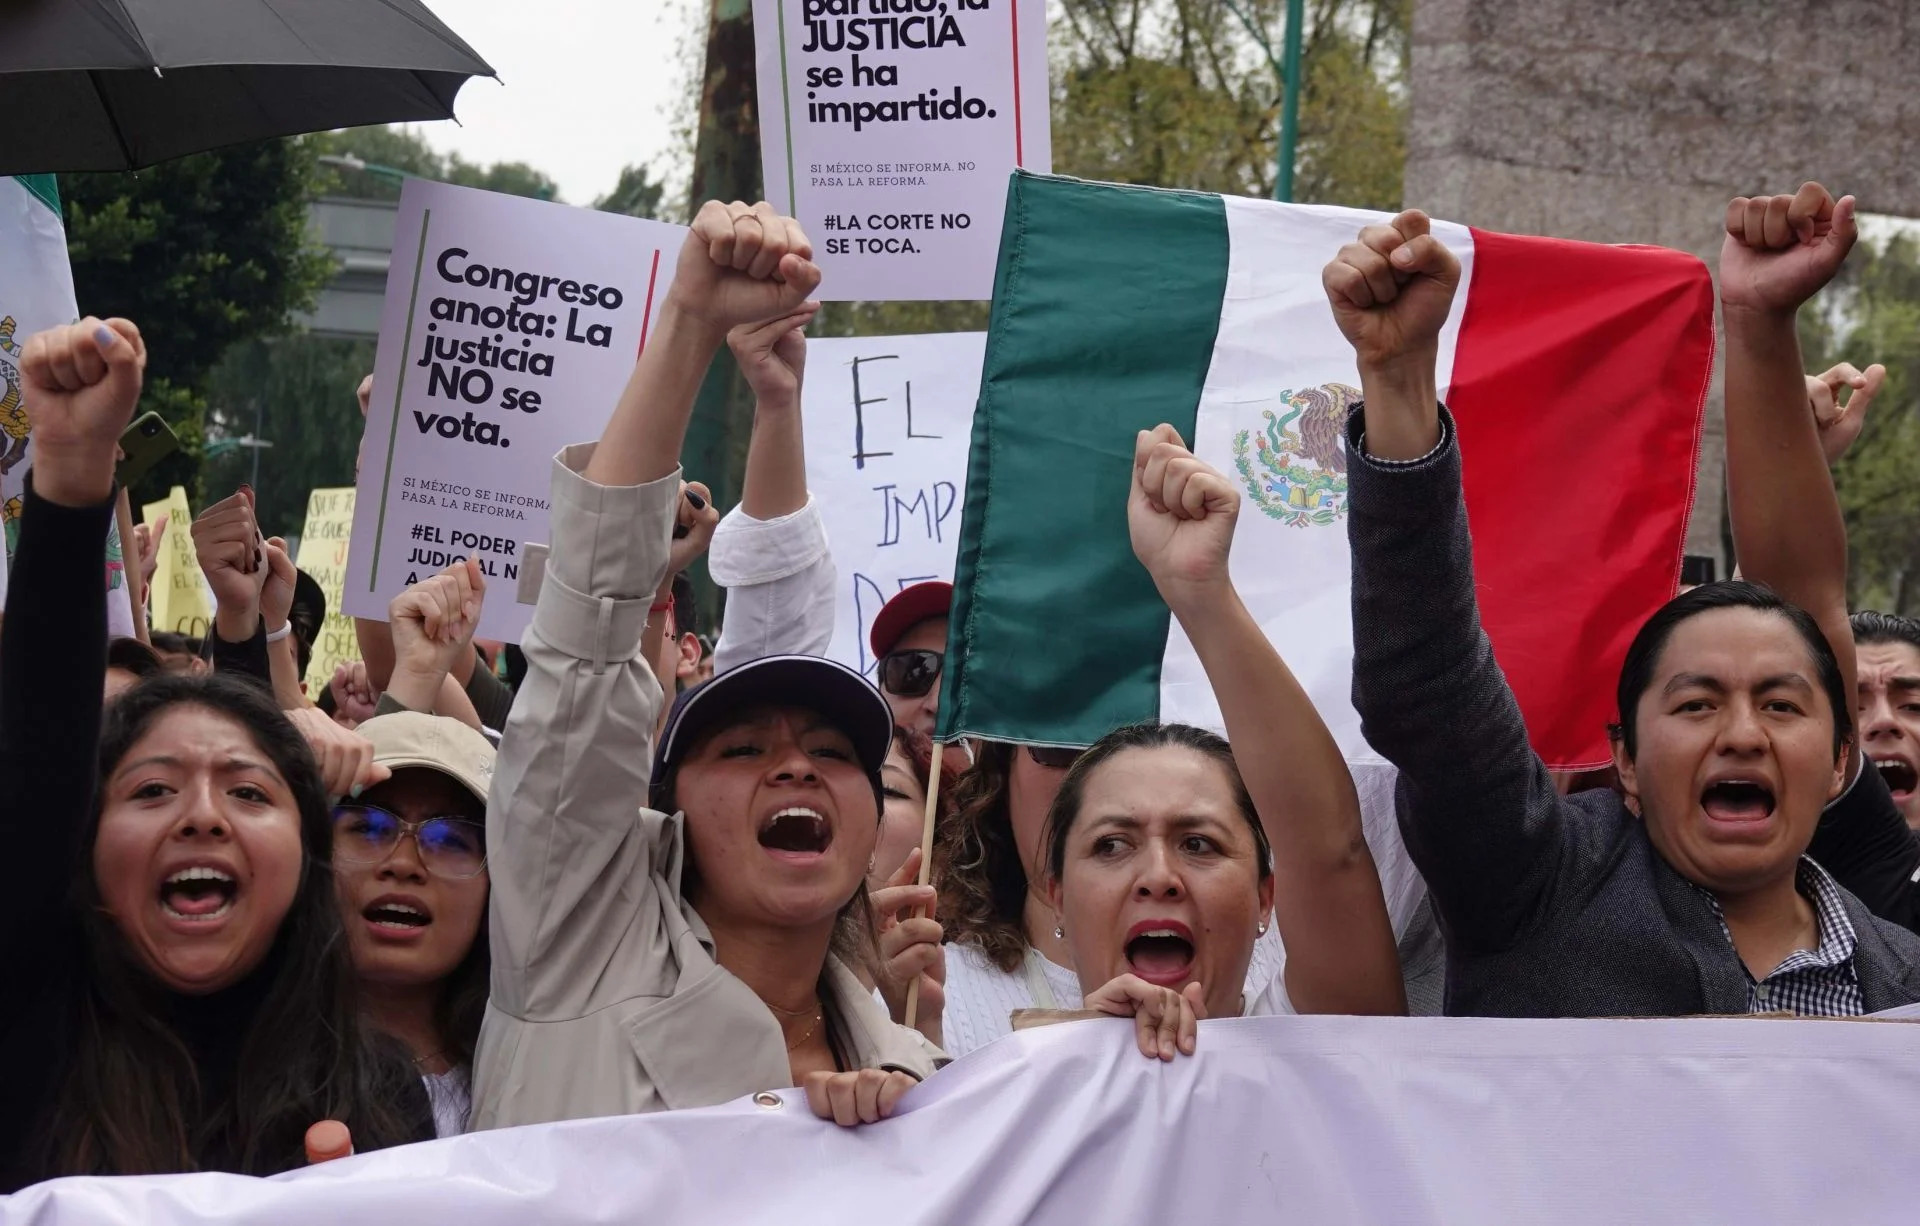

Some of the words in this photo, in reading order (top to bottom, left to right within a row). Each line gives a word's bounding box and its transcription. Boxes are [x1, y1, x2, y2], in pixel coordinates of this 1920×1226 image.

[801, 15, 967, 52] JUSTICIA
[806, 66, 844, 88] se
[851, 53, 898, 87] ha
[807, 86, 997, 132] impartido.
[810, 164, 822, 174] SI
[825, 162, 873, 174] MÉXICO
[876, 163, 892, 174] SE
[957, 161, 976, 172] NO
[811, 177, 844, 187] PASA
[848, 177, 864, 187] LA
[824, 214, 862, 231] #LA
[867, 213, 935, 231] CORTE
[940, 213, 971, 230] NO
[825, 238, 850, 255] SE
[854, 237, 921, 254] TOCA.
[436, 247, 623, 310] Congreso
[429, 296, 557, 339] anota:
[565, 307, 613, 348] La
[416, 322, 555, 377] justicia
[427, 361, 494, 405] NO
[499, 387, 542, 414] se
[414, 410, 511, 449] vota.
[400, 490, 437, 506] PASA
[440, 497, 459, 510] LA
[402, 476, 417, 488] SI
[419, 479, 471, 497] MÉXICO
[474, 488, 492, 501] SE
[410, 523, 444, 544] #EL
[450, 530, 516, 556] PODER
[407, 548, 498, 577] JUDIAL
[503, 563, 520, 580] N
